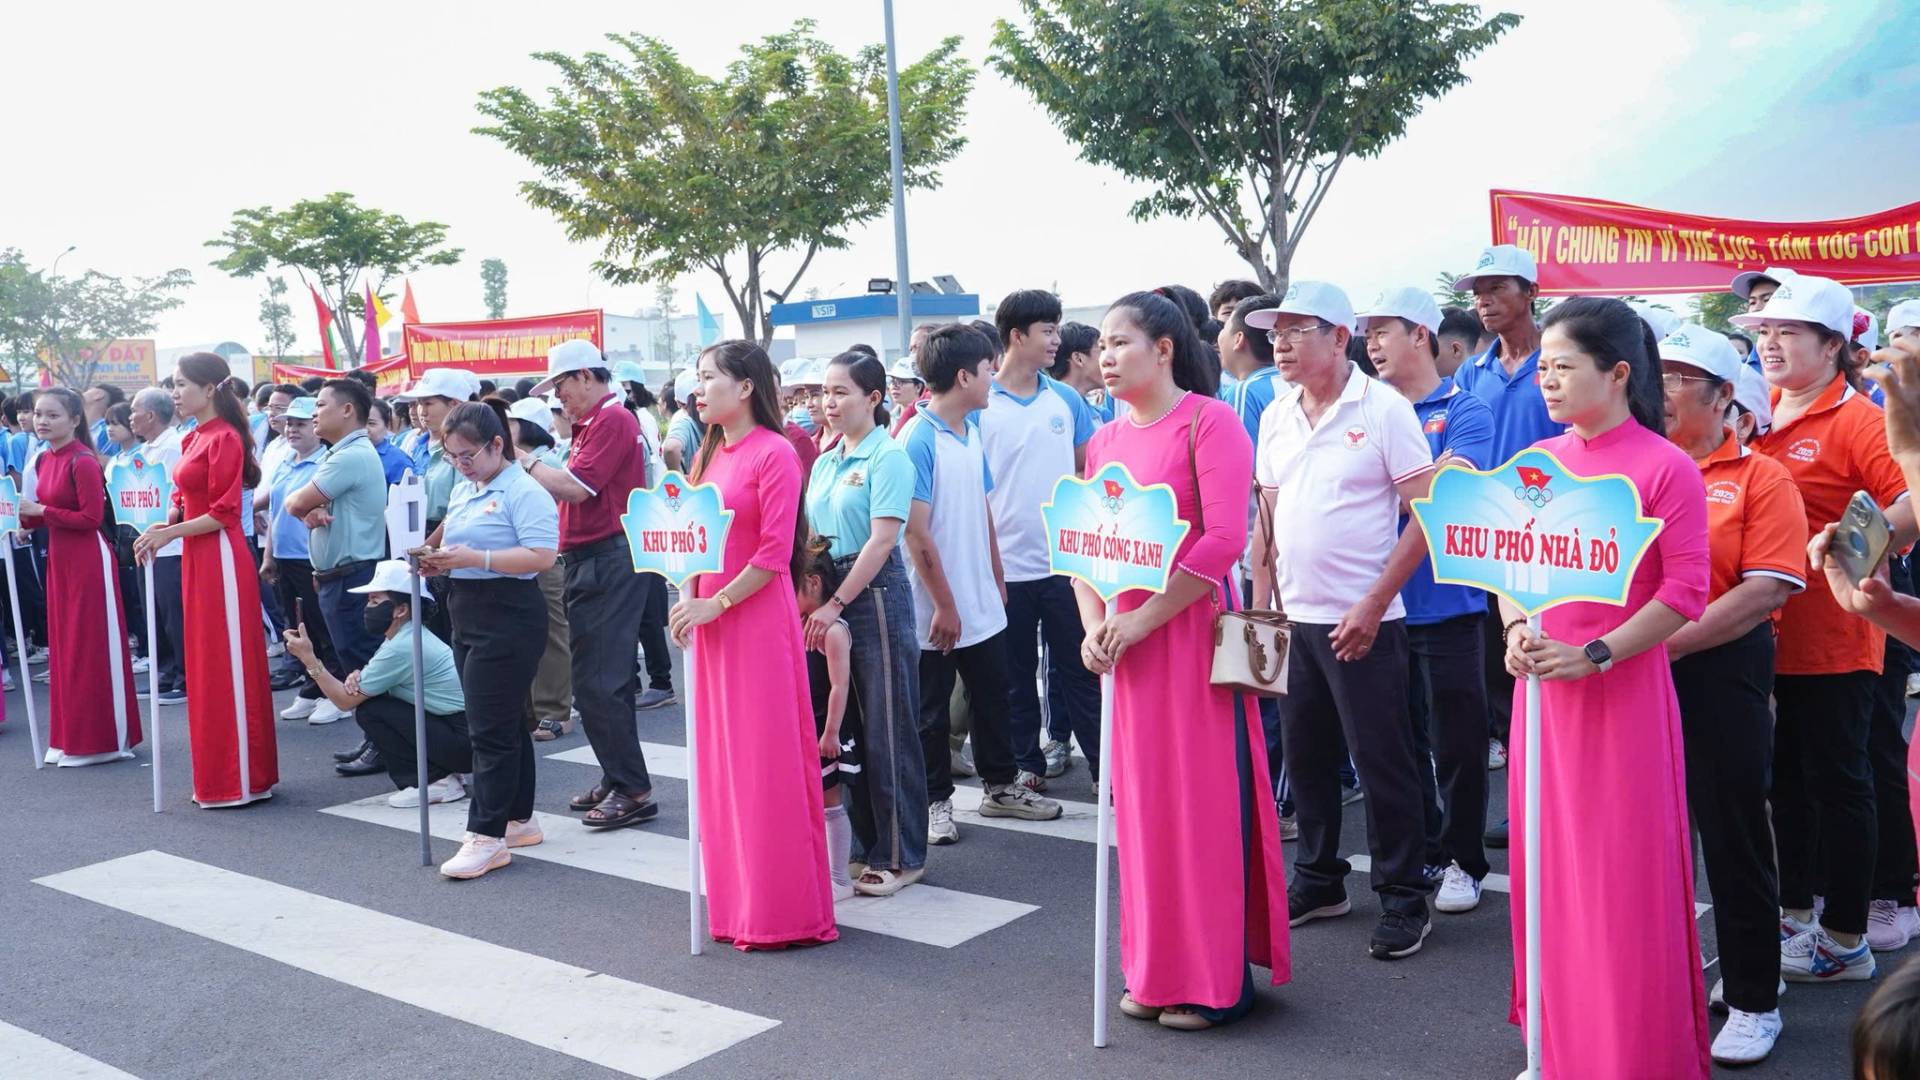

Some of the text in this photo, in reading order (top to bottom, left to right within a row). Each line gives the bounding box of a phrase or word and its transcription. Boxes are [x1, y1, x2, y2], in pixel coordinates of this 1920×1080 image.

[1556, 225, 1620, 264] CHUNG
[1624, 228, 1653, 263] TAY
[1657, 223, 1678, 263] VÌ
[1719, 232, 1766, 269] LỰC,
[1817, 231, 1858, 260] VÓC
[1864, 224, 1910, 258] CON
[120, 483, 161, 508] KHU PHỐ 2
[1712, 489, 1736, 499] 2025
[643, 520, 707, 553] KHU PHỐ 3
[1058, 522, 1163, 569] KHU PHỐ CỔNG XANH
[1445, 517, 1619, 573] KHU PHỐ NHÀ ĐỎ
